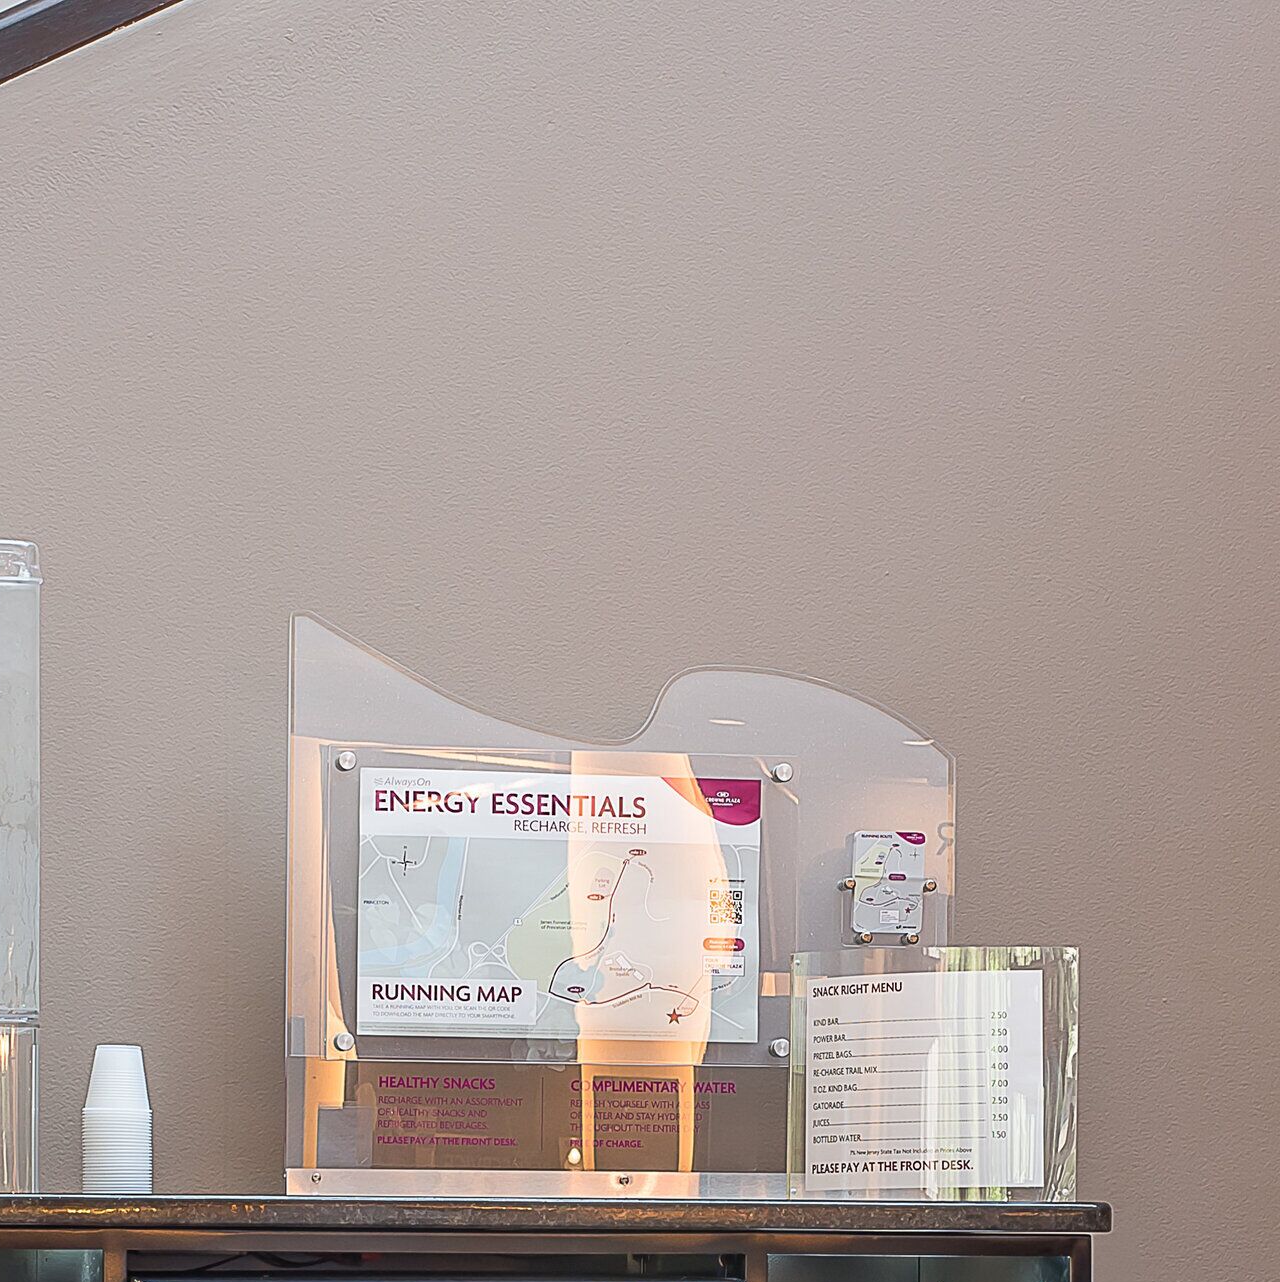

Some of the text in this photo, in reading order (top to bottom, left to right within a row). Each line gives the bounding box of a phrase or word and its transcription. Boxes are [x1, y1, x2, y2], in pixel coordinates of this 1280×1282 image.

[374, 789, 646, 819] ENERGY ESSENTIALS
[514, 819, 647, 835] RECHARGE, REFRESH
[372, 984, 522, 1002] RUNNING MAP
[812, 981, 903, 997] SNACK RIGHT MENU
[813, 1011, 1007, 1027] KIND BAR 2.50
[813, 1028, 1008, 1044] POWER BAR 2.50
[813, 1051, 835, 1060] PRETZEL
[836, 1050, 853, 1059] BAGS
[813, 1067, 845, 1077] RE-CHARGE
[845, 1066, 863, 1076] TRAIL
[864, 1065, 879, 1075] MIX
[378, 1076, 496, 1090] HEALTHY SNACKS
[571, 1080, 737, 1094] COMPLIMENTARY WATER
[828, 1085, 843, 1093] KIND
[843, 1084, 858, 1092] BAG
[378, 1095, 524, 1107] RECHARGE WITH AN ASSORTMENT
[570, 1100, 710, 1110] RERESH YOURSELF WITH GASS
[813, 1096, 1008, 1110] GATORADE 2.50
[377, 1108, 488, 1118] OF HEALTHY SNACKS AND
[570, 1112, 582, 1120] OF
[615, 1112, 634, 1120] AND
[636, 1112, 655, 1121] STAY
[657, 1113, 702, 1121] HYDRATD
[377, 1120, 489, 1130] REFRIGERATED BEVERAGES.
[570, 1124, 633, 1132] THOUGHOUT
[635, 1124, 651, 1132] THE
[812, 1114, 1009, 1128] JUICES 2.50
[377, 1136, 517, 1146] PLEASE PAY AT THE FRONT DESK.
[592, 1140, 604, 1148] OF
[605, 1140, 644, 1148] CHARGE.
[812, 1130, 1007, 1144] BOTTLED WATER 1.50
[812, 1160, 974, 1174] PLEASE PAY AT THE FRONT DESK.
